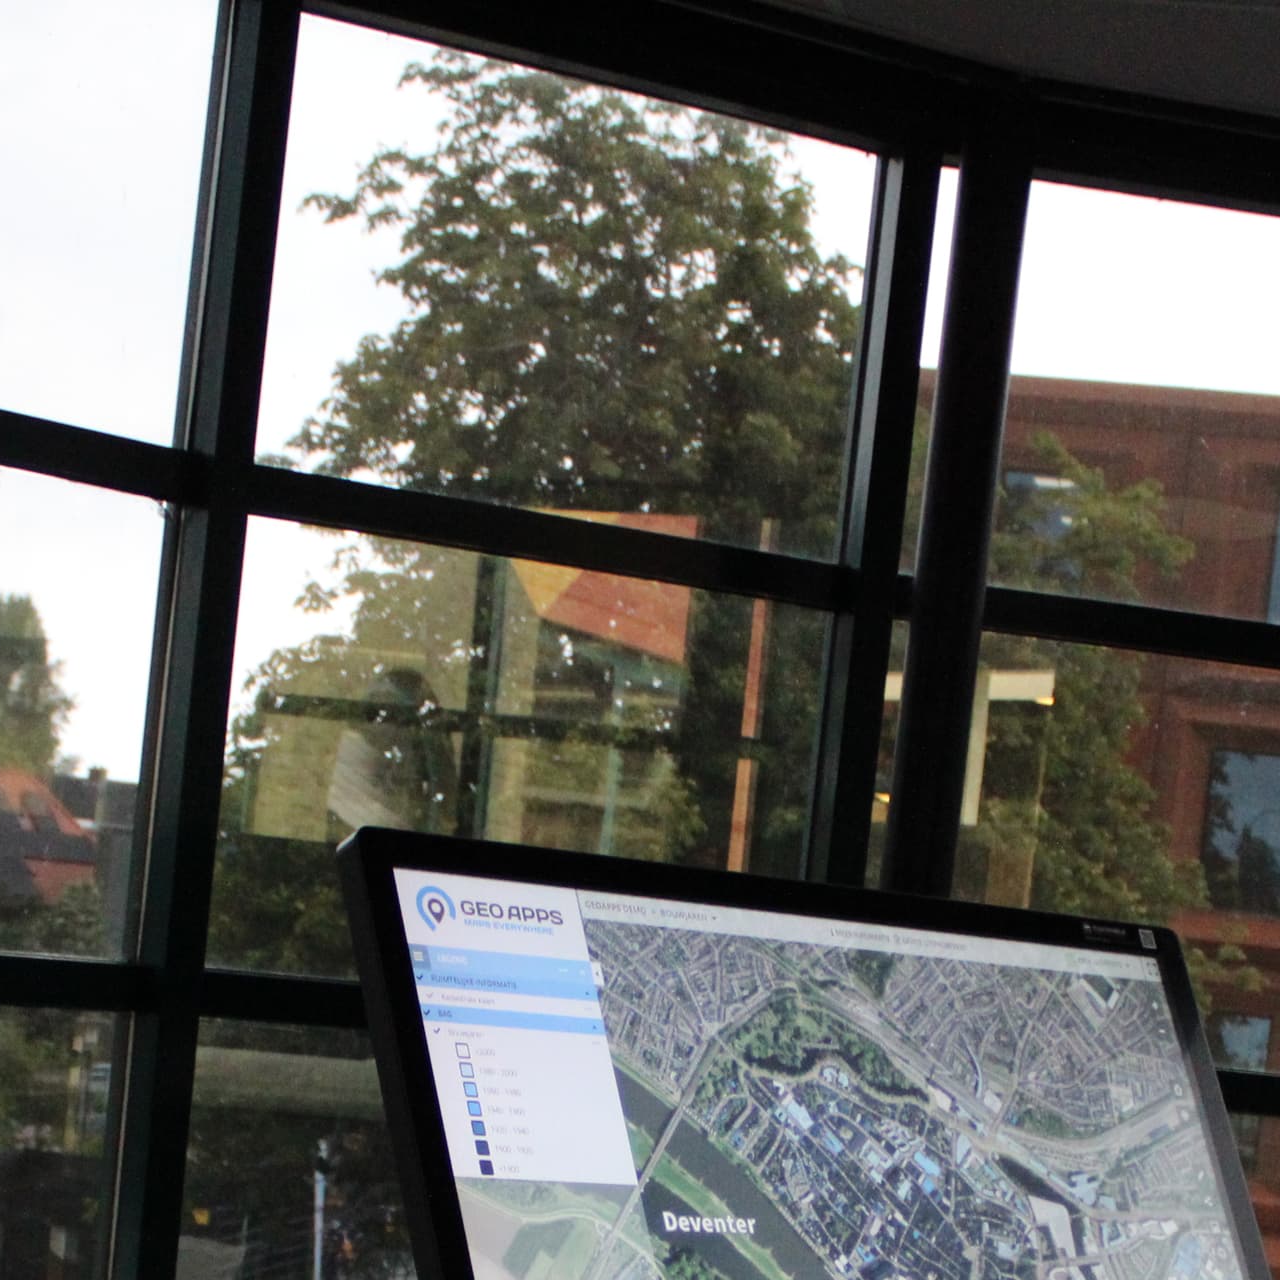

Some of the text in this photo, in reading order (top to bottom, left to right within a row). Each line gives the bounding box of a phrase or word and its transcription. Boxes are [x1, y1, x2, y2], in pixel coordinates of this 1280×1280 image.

[459, 899, 564, 925] GEO APPS
[663, 1211, 756, 1235] Deventer
